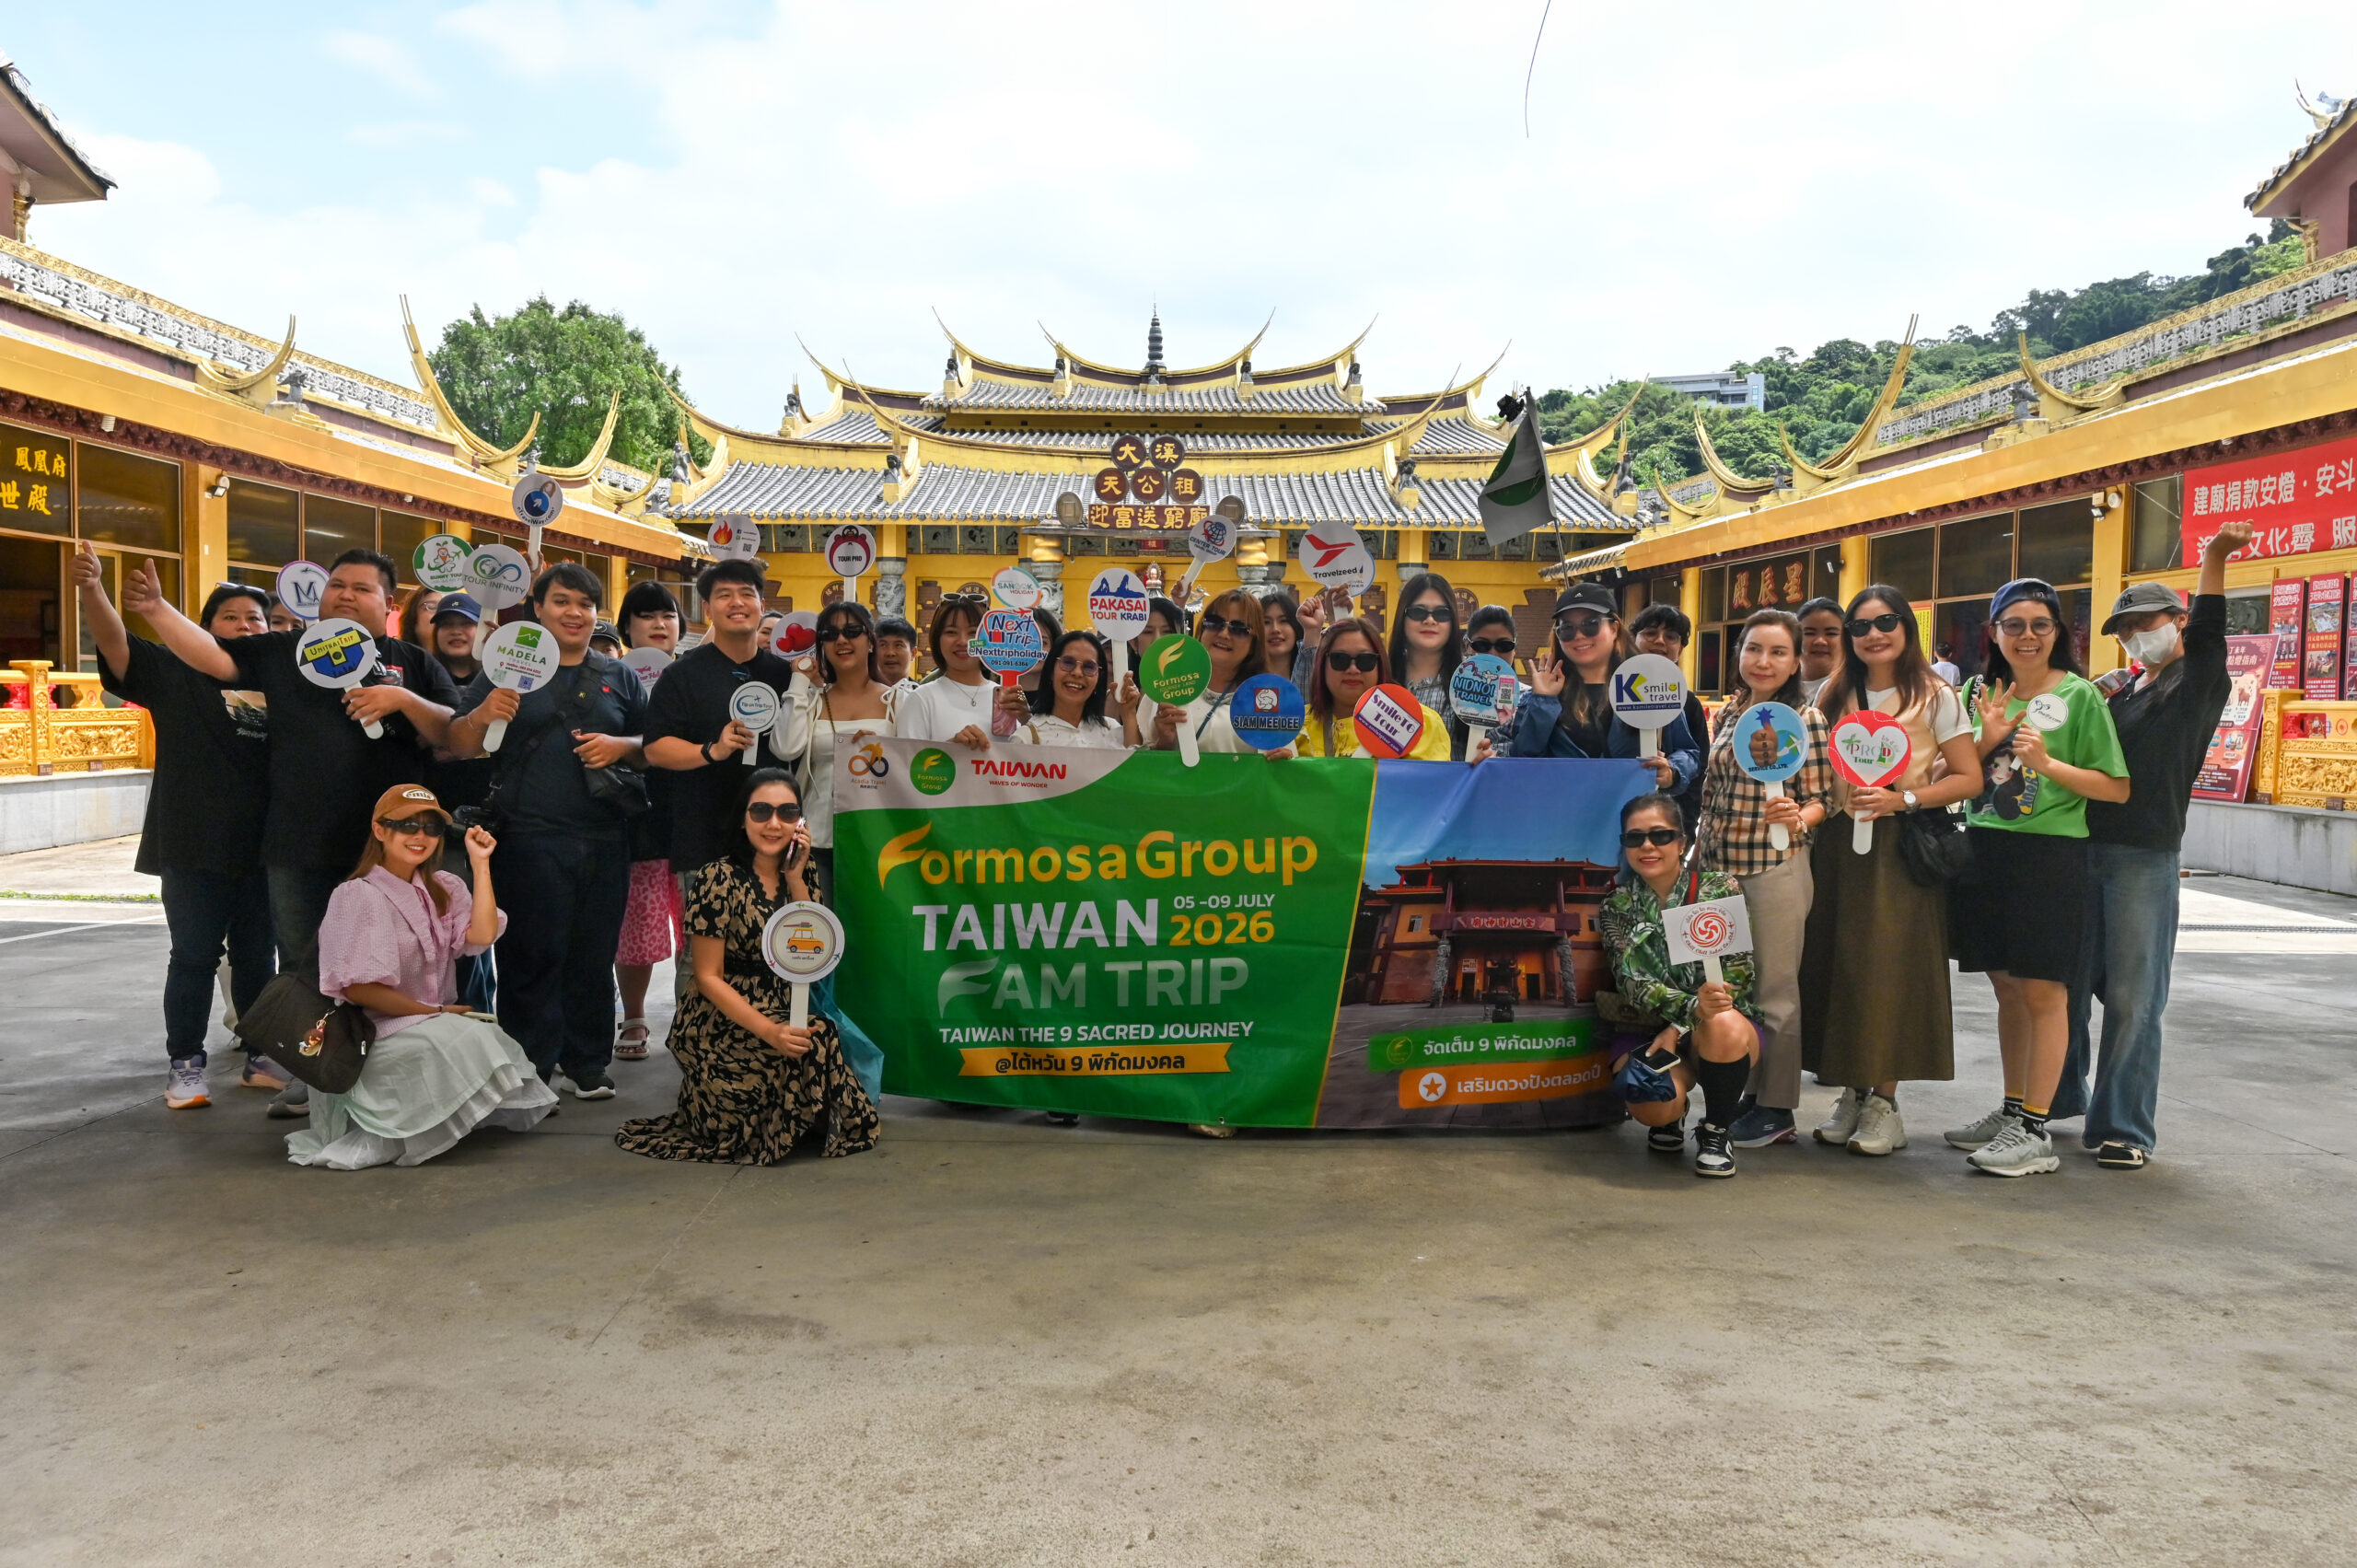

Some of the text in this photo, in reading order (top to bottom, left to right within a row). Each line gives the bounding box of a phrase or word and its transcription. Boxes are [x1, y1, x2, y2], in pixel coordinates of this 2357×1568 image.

[15, 447, 66, 478] 鳳凰府
[1117, 442, 1179, 464] 大溪
[1100, 474, 1197, 495] 天公祖
[1190, 536, 1226, 555] CENTER TOUR
[1313, 566, 1357, 578] Travelzeed
[463, 575, 487, 587] TOUR
[489, 581, 526, 595] INFINITY
[1089, 598, 1146, 612] PAKASAI
[991, 614, 1034, 632] Next
[1091, 610, 1147, 621] TOUR KRABI
[1006, 632, 1033, 647] Trip
[497, 645, 547, 666] MADELA
[969, 646, 1048, 659] @Nexttripholiday
[1153, 671, 1200, 690] Formosa
[1453, 676, 1495, 697] NIDNOI
[1163, 686, 1195, 700] Group
[1455, 691, 1492, 706] TRAVEL
[1233, 715, 1300, 729] SIAM MEE DEE
[1374, 710, 1399, 737] Tour
[970, 759, 1066, 780] TAIWAN
[1852, 756, 1874, 764] Tour
[917, 773, 947, 782] Formosa
[921, 783, 942, 791] Group
[877, 823, 1318, 891] Formosa Group
[1173, 893, 1275, 910] 05 -09 JULY
[911, 898, 1158, 951] TAIWAN
[1169, 911, 1275, 947] 2026
[937, 956, 1249, 1019] FAM TRIP
[939, 1021, 1254, 1044] TAIWAN THE 9 SACRED JOURNEY
[1423, 1035, 1474, 1056] จัดเต็ม
[1479, 1039, 1490, 1051] 9
[1494, 1034, 1576, 1051] พิกัดมงคล
[994, 1051, 1185, 1074] @ไต้หวัน 9 พิกัดมงคล
[1457, 1064, 1601, 1094] เสริมดวงปังตลอดปี
